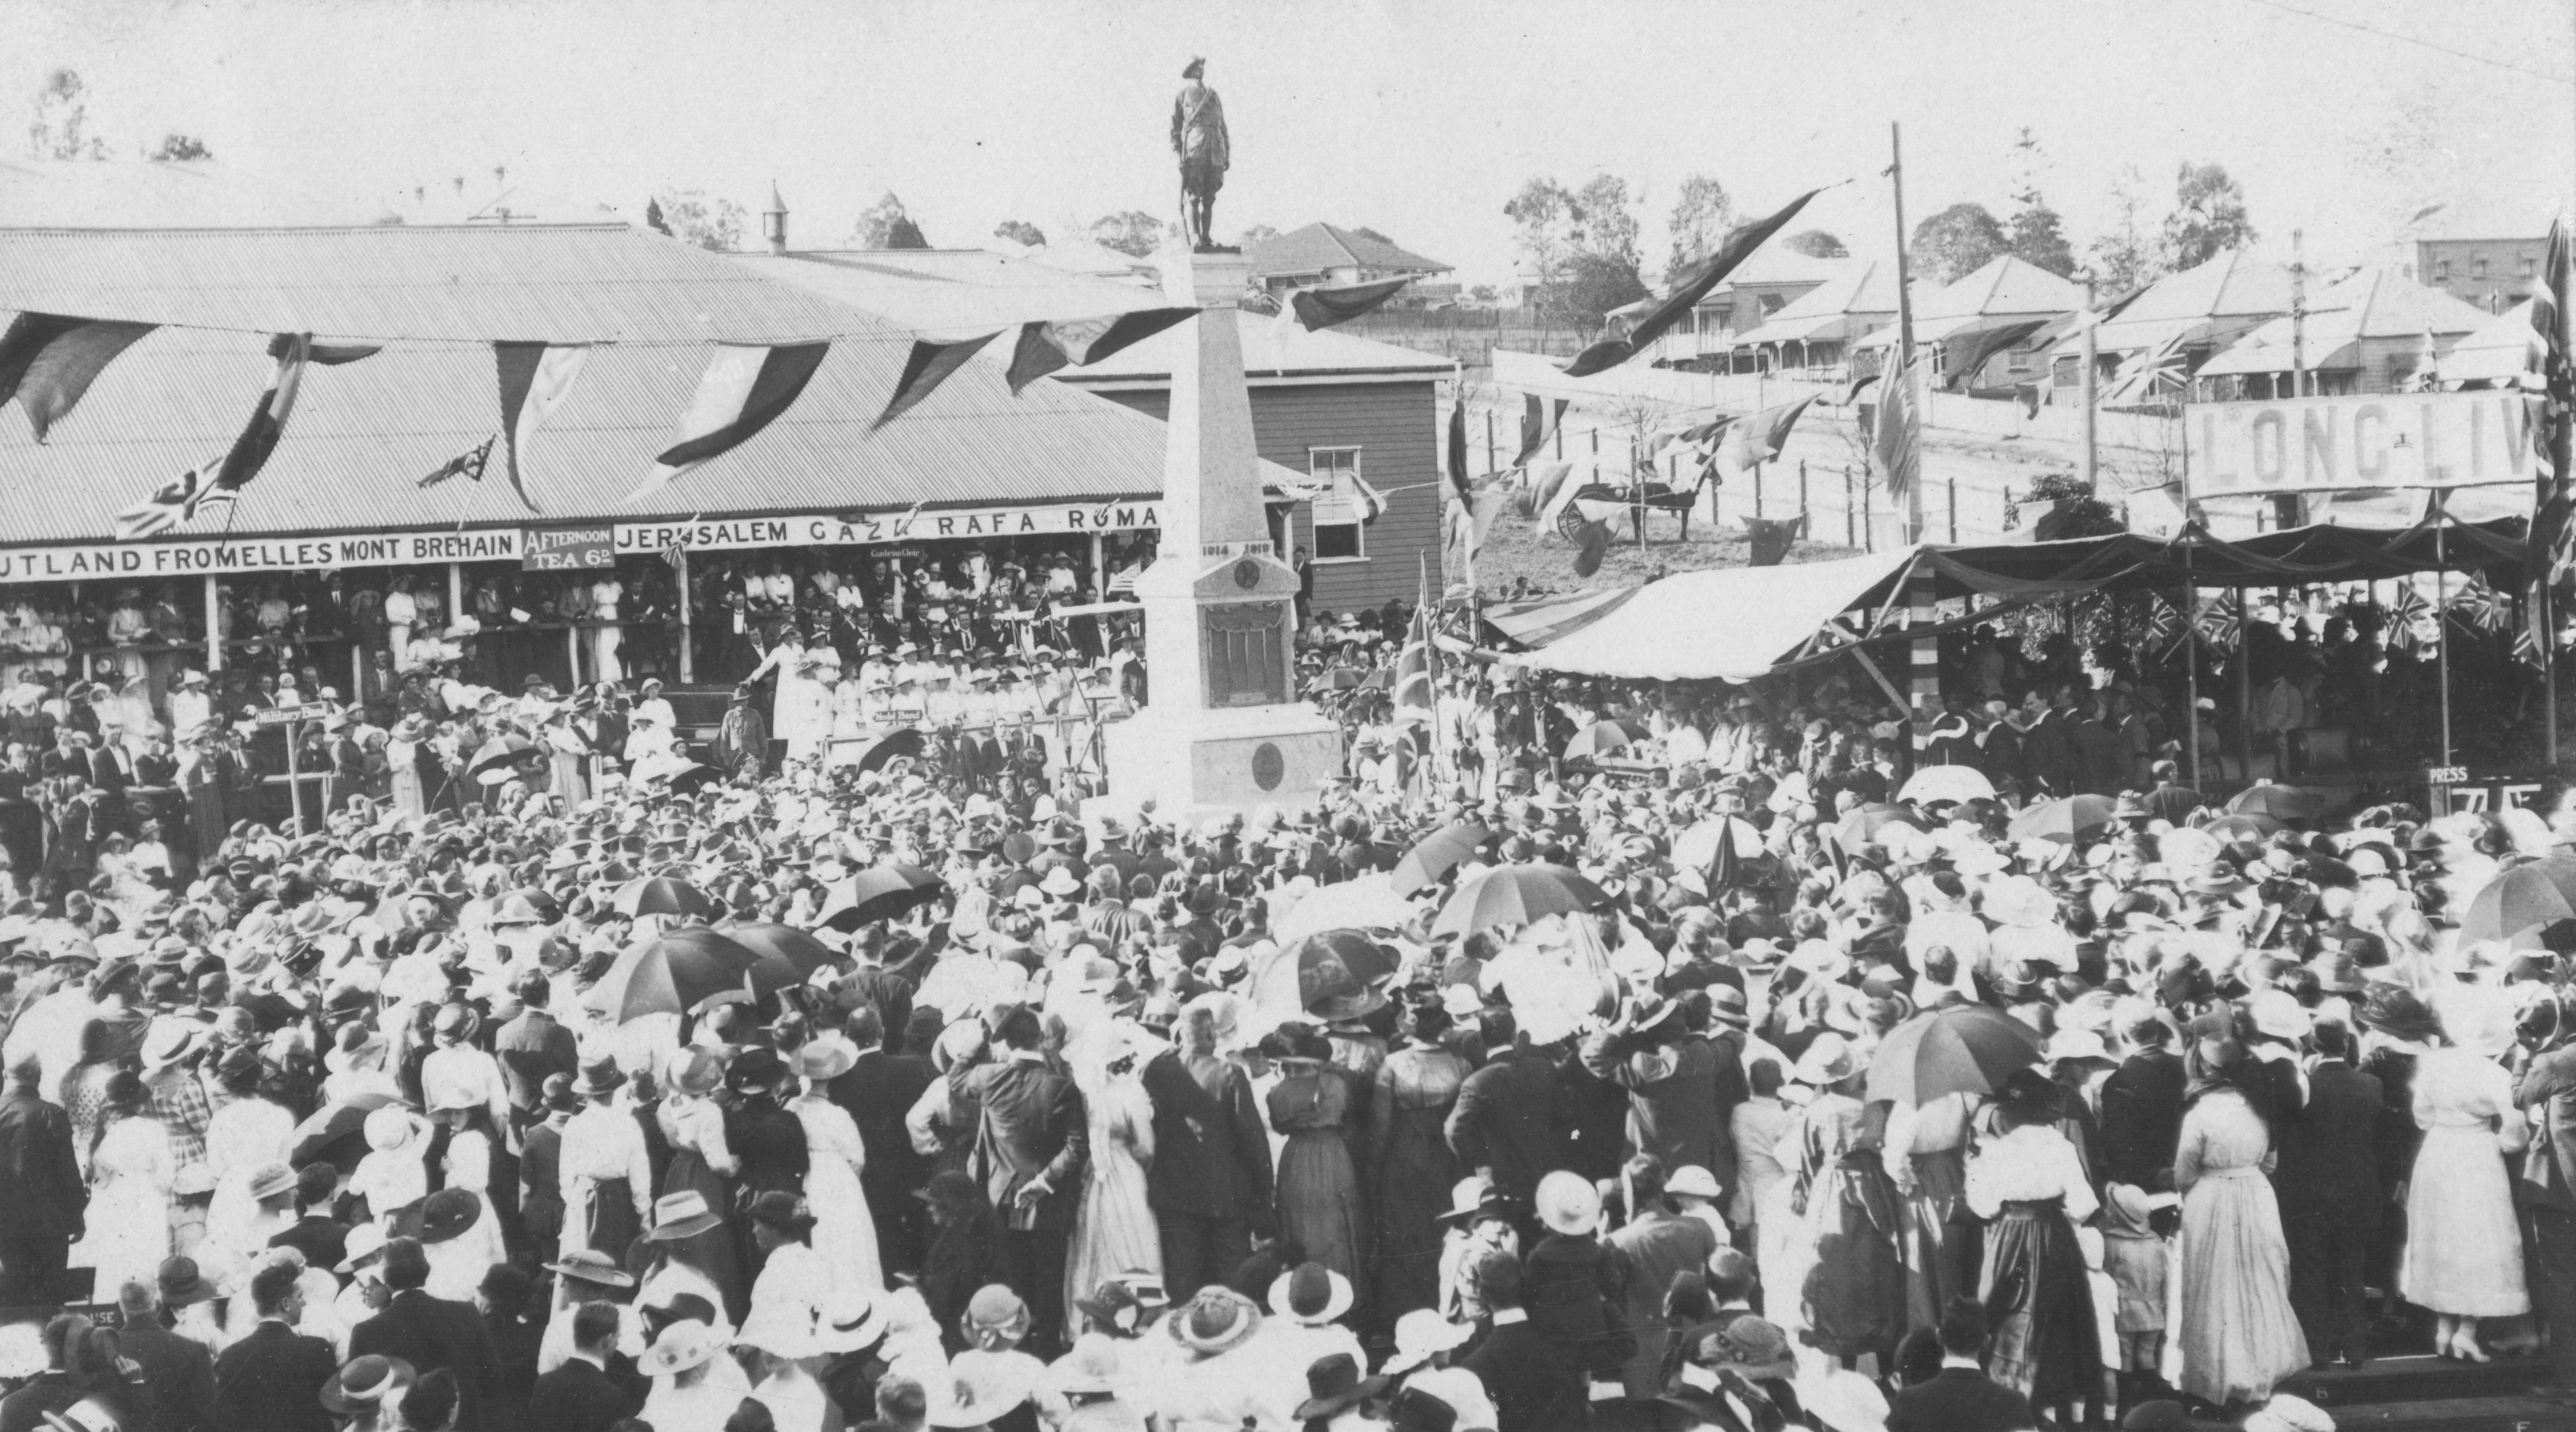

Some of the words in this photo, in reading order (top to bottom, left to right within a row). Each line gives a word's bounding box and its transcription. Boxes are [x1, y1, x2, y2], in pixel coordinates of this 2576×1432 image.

[2203, 403, 2389, 486] LONG
[938, 513, 1036, 535] RAFA
[523, 530, 610, 554] AFTERNOON
[902, 548, 920, 556] Choir
[1203, 544, 1229, 556] 1914
[1244, 543, 1269, 554] 1919
[155, 543, 332, 570] FROMELLES
[341, 538, 400, 561] MONT
[413, 535, 512, 558] BREHAIN
[532, 552, 579, 569] TEA
[2430, 766, 2468, 784] PRESS
